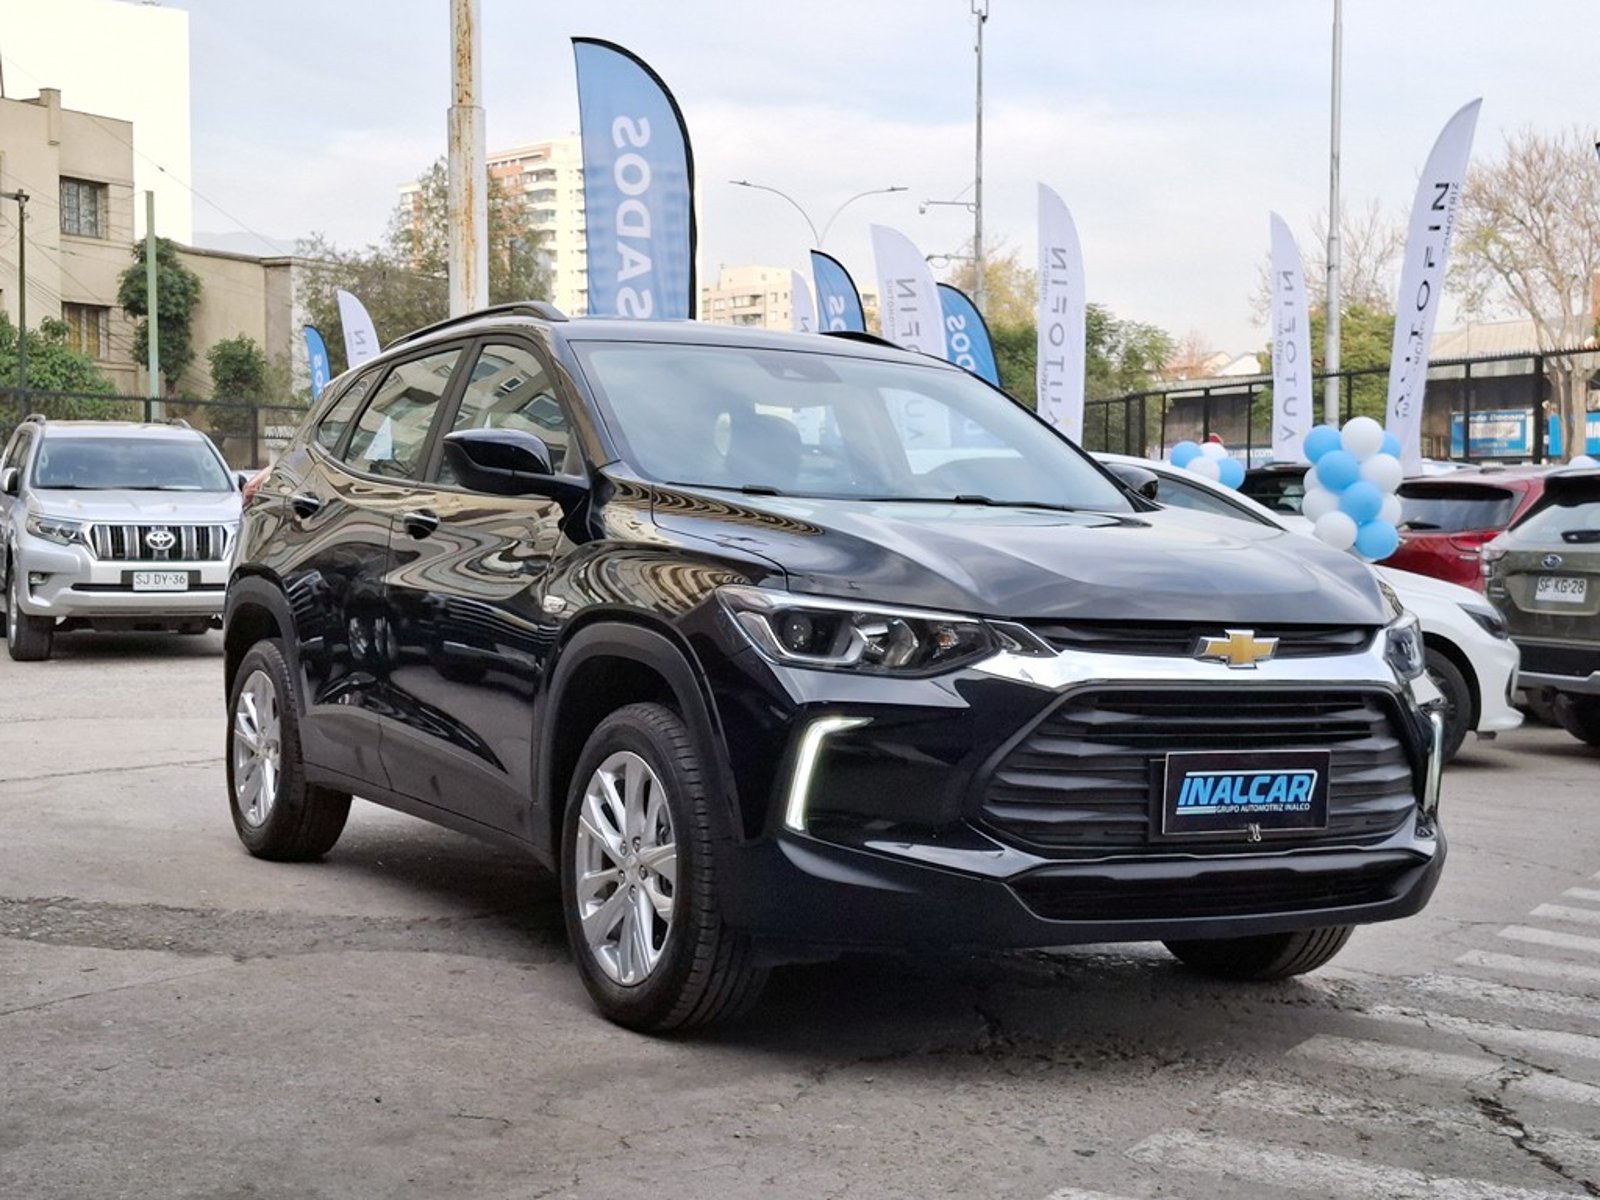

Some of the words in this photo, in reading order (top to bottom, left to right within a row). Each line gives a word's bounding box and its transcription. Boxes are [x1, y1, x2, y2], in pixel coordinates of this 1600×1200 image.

[1178, 775, 1311, 805] INALCAR
[1216, 805, 1239, 813] GRUPO
[1241, 804, 1283, 812] AUTOMOTRIZ
[1285, 803, 1310, 811] INALCO
